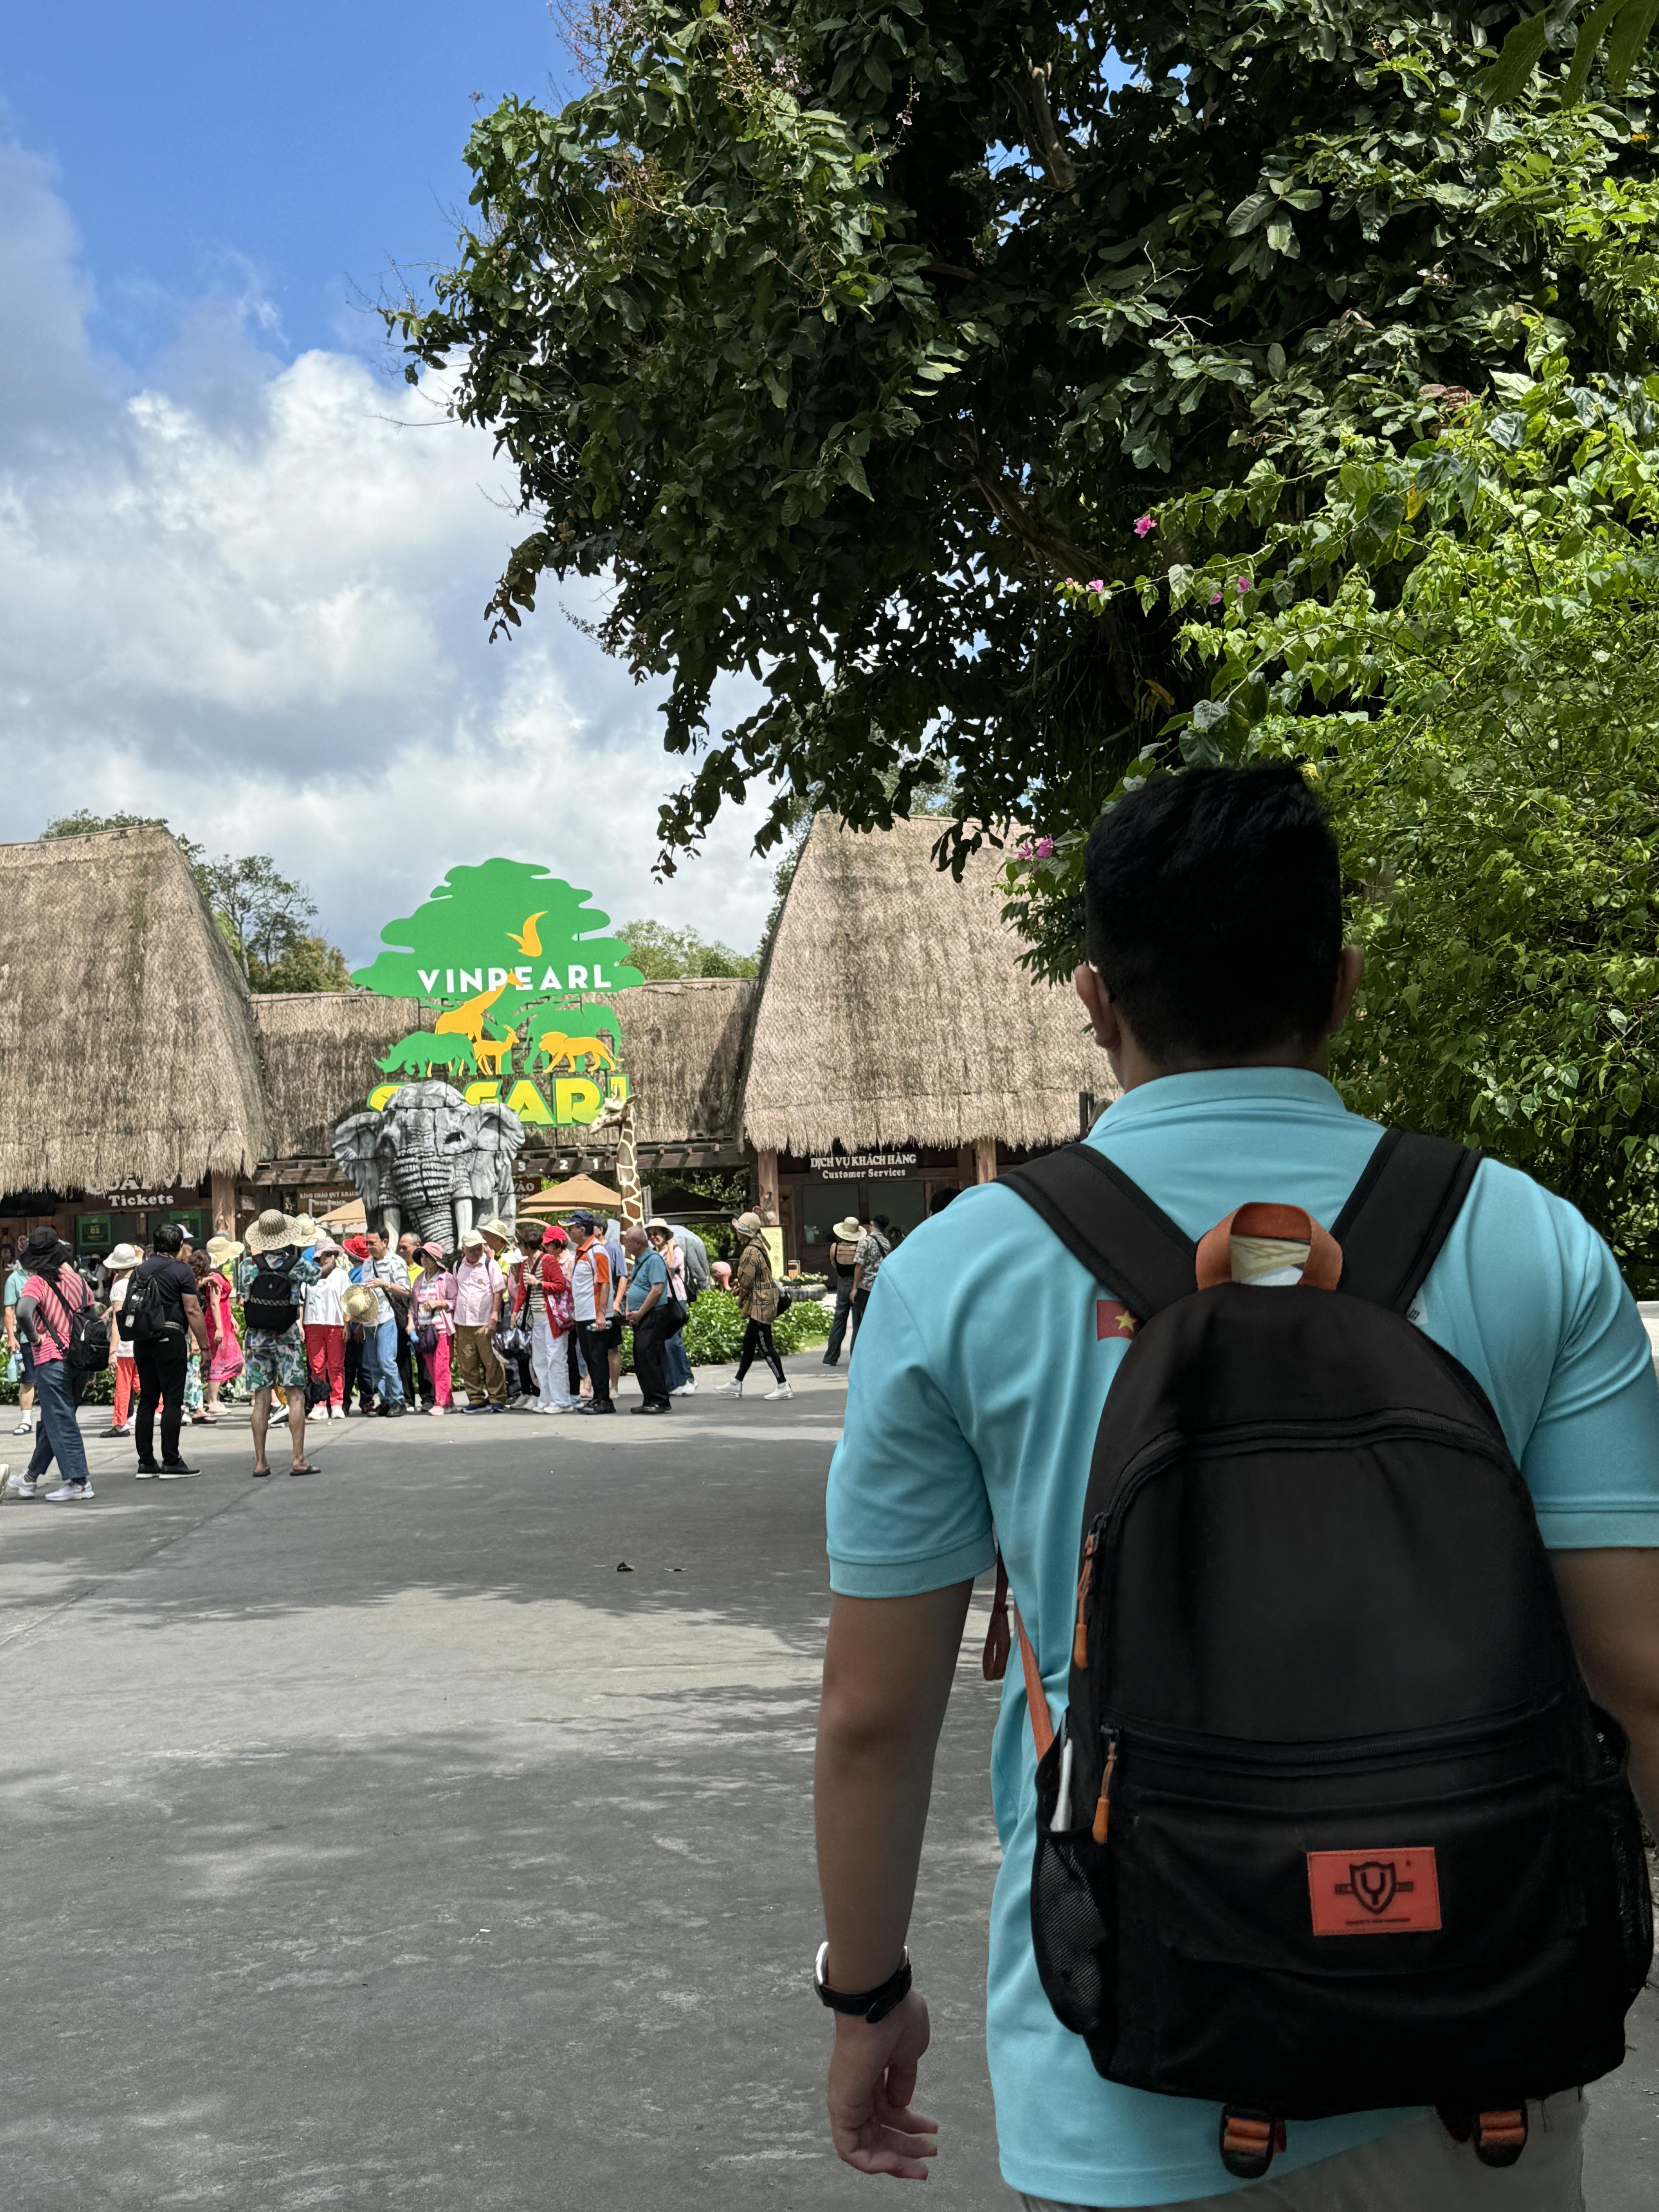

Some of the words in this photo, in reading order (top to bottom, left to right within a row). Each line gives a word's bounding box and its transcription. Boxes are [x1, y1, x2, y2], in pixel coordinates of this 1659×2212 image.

[417, 964, 611, 994] VINPEARL
[370, 1076, 627, 1125] FAR
[518, 1161, 526, 1171] 3
[559, 1159, 568, 1170] 2
[592, 1158, 599, 1170] 1
[811, 1157, 834, 1170] DỊCH
[835, 1156, 850, 1169] VỤ
[852, 1153, 886, 1166] KHÁCH
[887, 1152, 917, 1165] HÀNG
[822, 1170, 866, 1179] Customer
[868, 1168, 906, 1177] Services
[108, 1194, 174, 1207] Tickets
